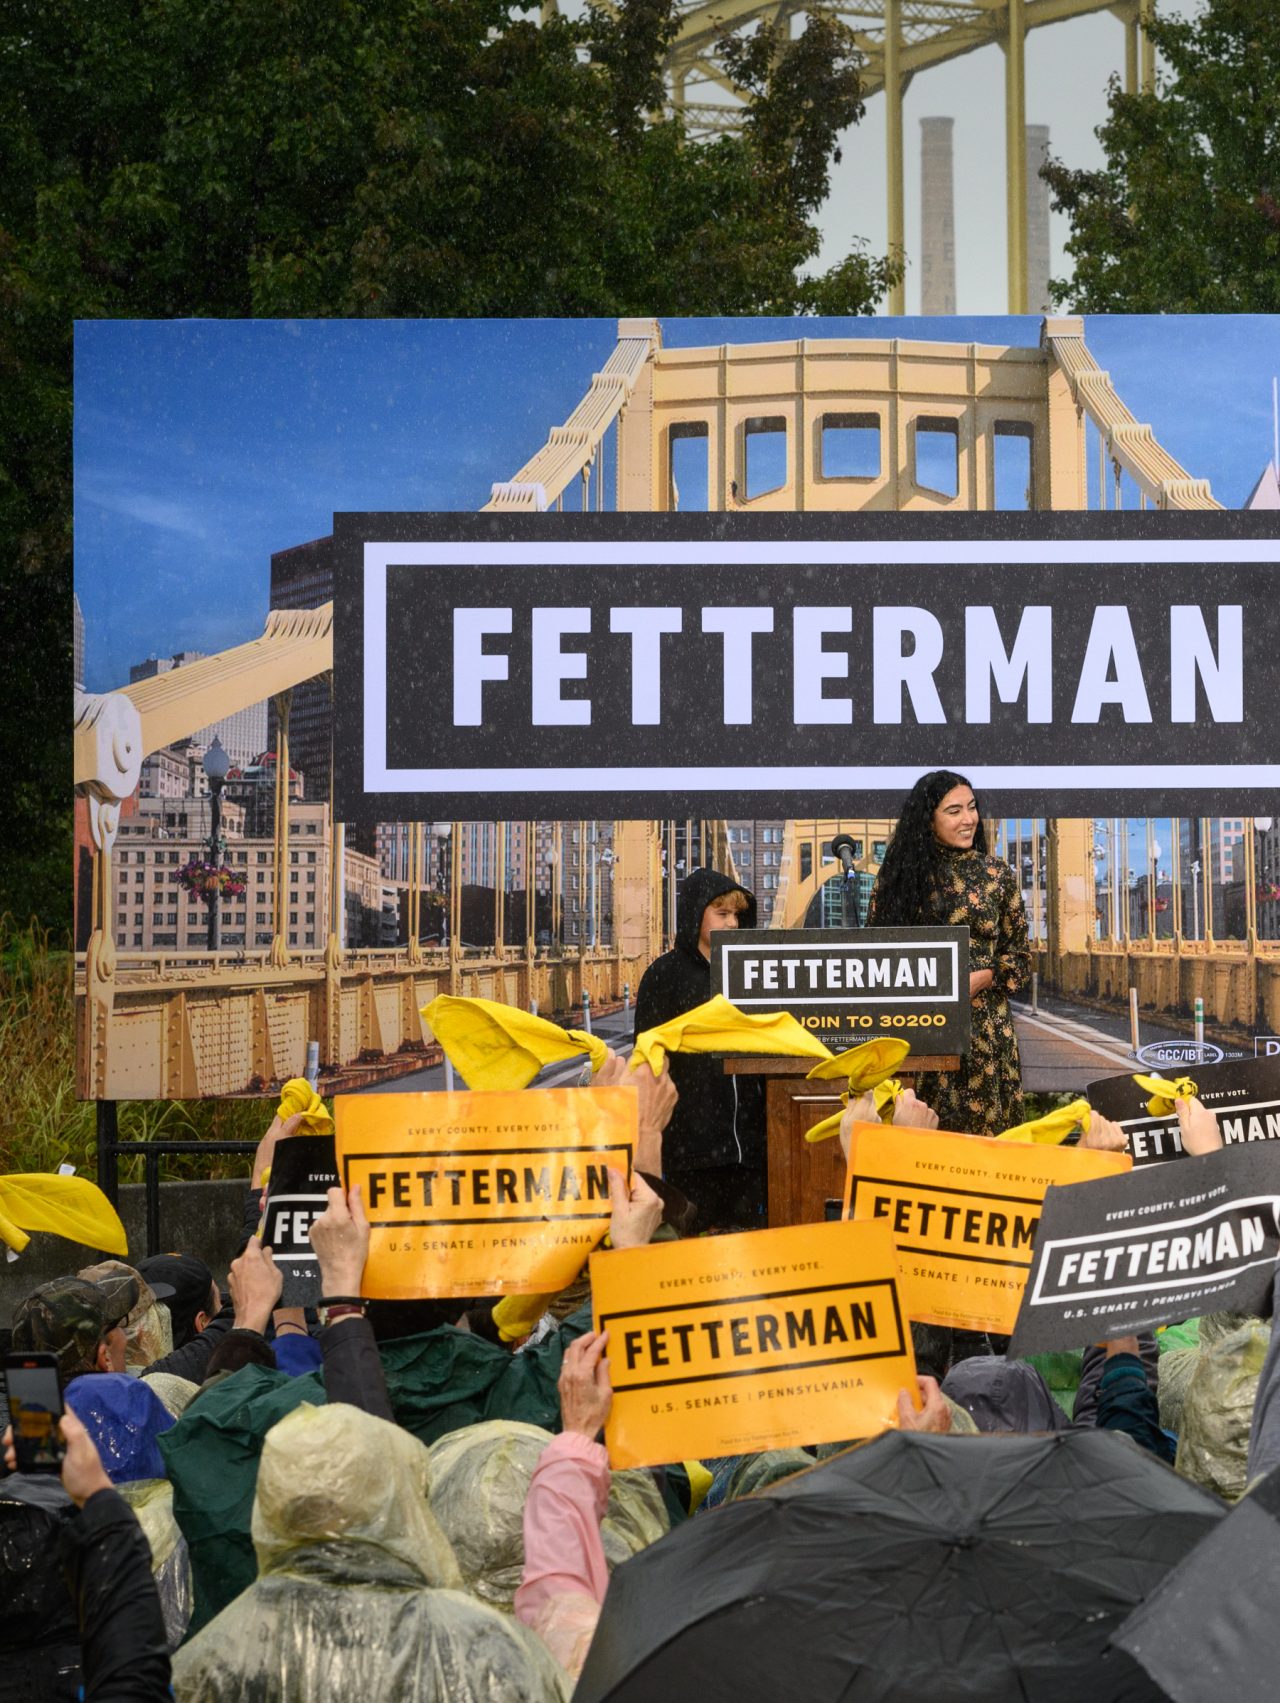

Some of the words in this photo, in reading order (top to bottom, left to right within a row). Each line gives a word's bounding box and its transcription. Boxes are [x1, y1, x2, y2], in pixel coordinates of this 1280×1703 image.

[453, 605, 1244, 727] FETTERMAN
[743, 957, 937, 990] FETTERMAN
[846, 1015, 873, 1028] TO
[879, 1014, 946, 1028] 30200
[1157, 1049, 1203, 1061] GCC/IBT
[1201, 1091, 1225, 1100] EVERY
[1227, 1088, 1249, 1098] VOTE.
[408, 1127, 441, 1136] EVERY
[447, 1126, 493, 1135] COUNTY.
[497, 1124, 530, 1133] EVERY
[308, 1173, 336, 1182] EVERY
[915, 1161, 946, 1172] EVERY
[949, 1165, 991, 1179] COUNTY.
[996, 1172, 1028, 1183] EVERY
[368, 1164, 610, 1209] FETTERMAN
[1106, 1209, 1135, 1221] EVERY
[1138, 1201, 1176, 1216] COUNTY.
[1179, 1193, 1207, 1208] EVERY
[1208, 1184, 1229, 1200] VOTE.
[389, 1242, 416, 1252] U.S.
[422, 1239, 474, 1250] SENATE
[1057, 1215, 1265, 1288] FETTERMAN
[292, 1269, 317, 1278] U.S.
[659, 1277, 694, 1289] EVERY
[752, 1264, 788, 1278] EVERY
[792, 1261, 824, 1273] VOTE.
[913, 1267, 958, 1283] SENATE
[975, 1276, 1028, 1291] PENNSY
[1063, 1309, 1087, 1319] U.S.
[1092, 1300, 1138, 1316] SENATE
[624, 1301, 877, 1370] FETTERMAN
[651, 1402, 679, 1414] U.S.
[685, 1393, 739, 1409] SENATE
[758, 1377, 865, 1401] PENNSYLVANIA
